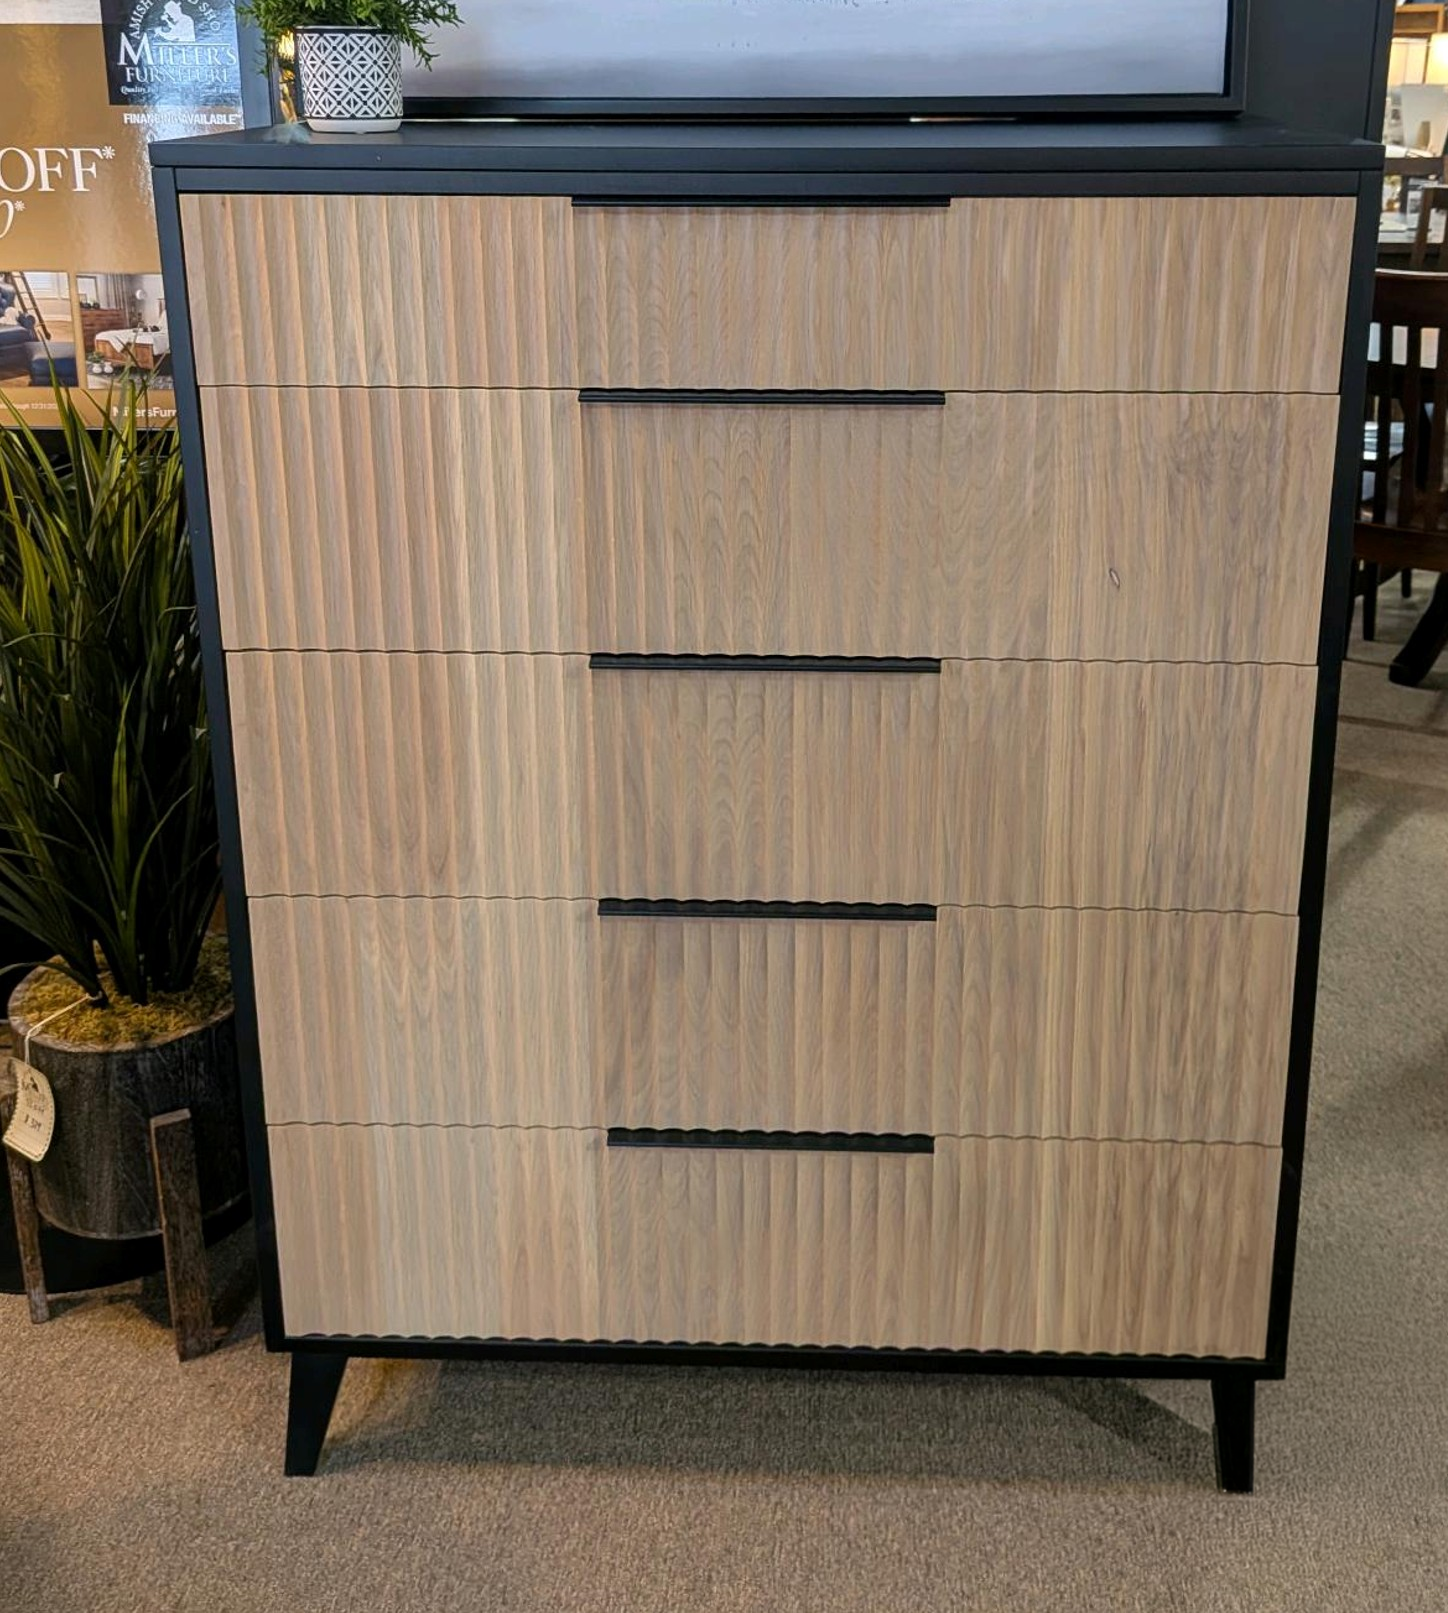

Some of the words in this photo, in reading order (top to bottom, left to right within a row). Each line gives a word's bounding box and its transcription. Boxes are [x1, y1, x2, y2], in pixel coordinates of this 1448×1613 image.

[129, 0, 154, 39] AMISH
[125, 66, 231, 84] FURNITURE
[123, 113, 179, 125] FINANCING
